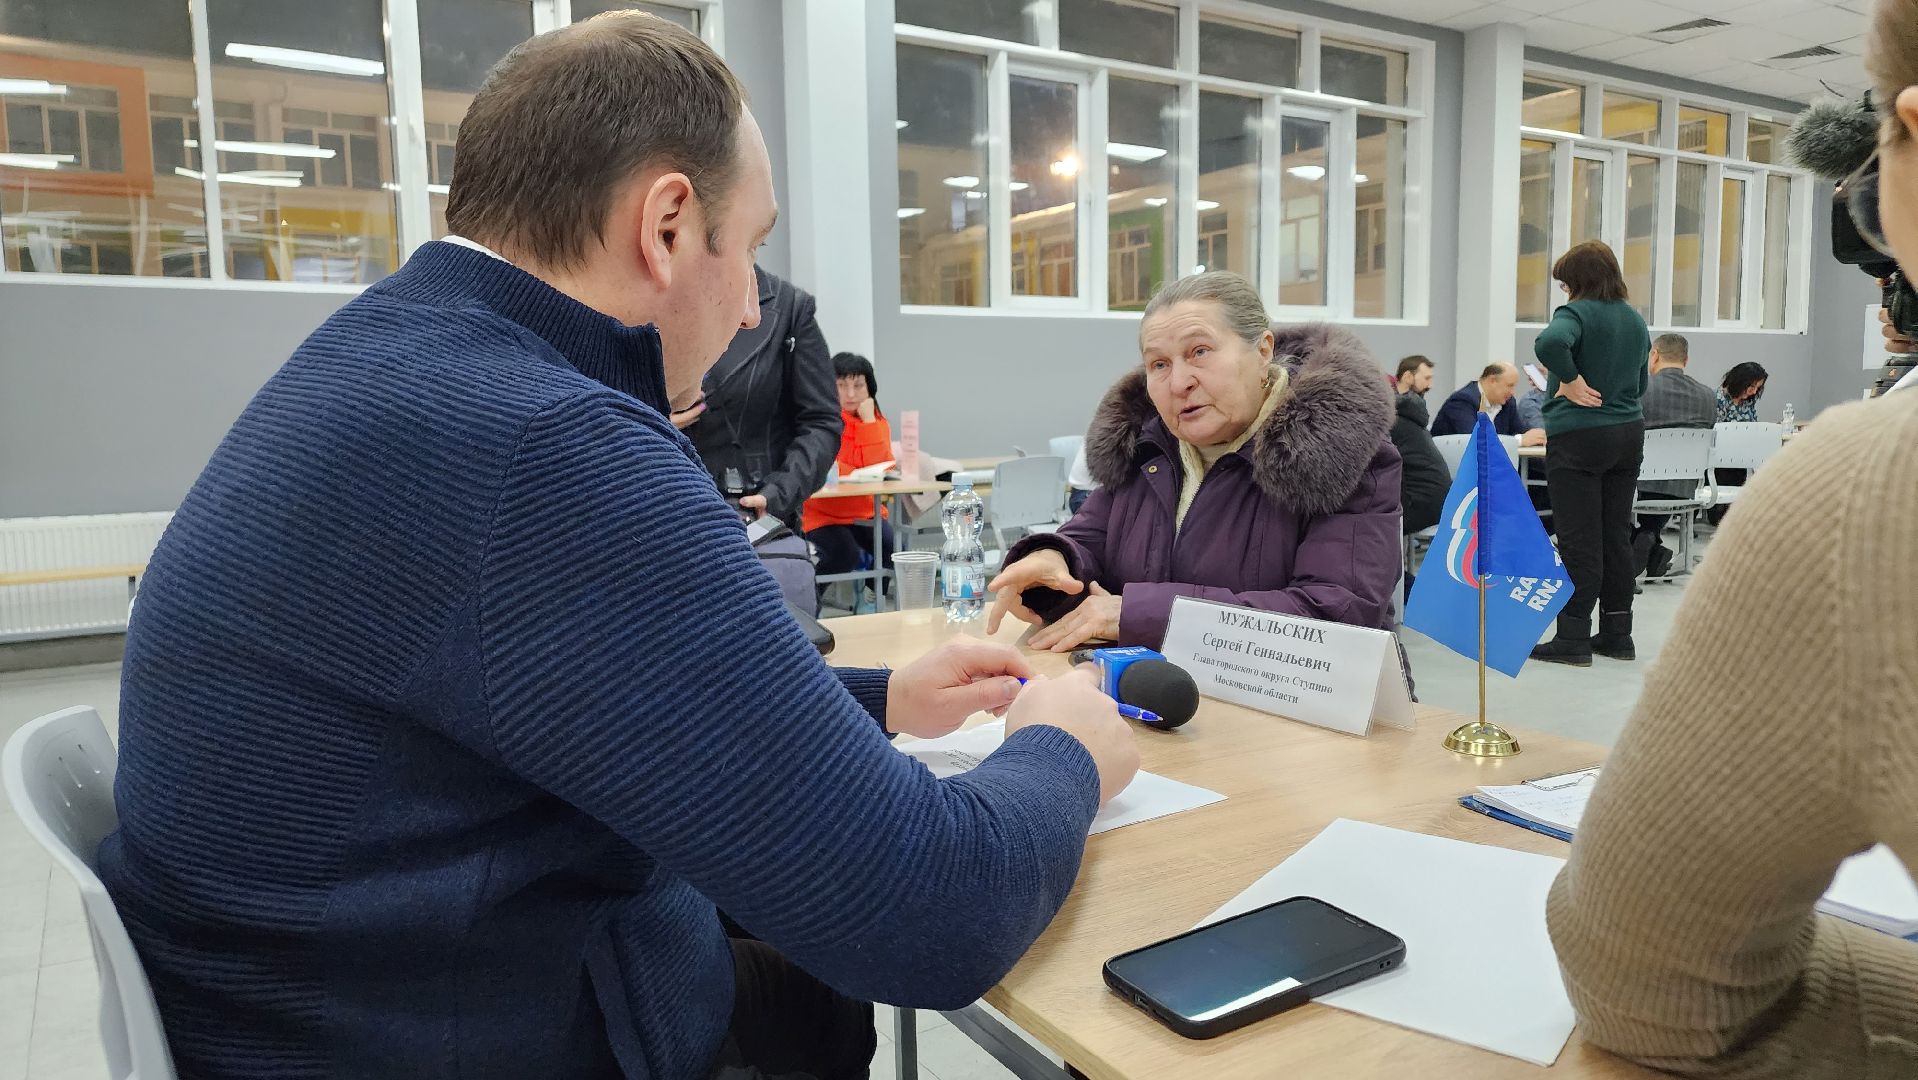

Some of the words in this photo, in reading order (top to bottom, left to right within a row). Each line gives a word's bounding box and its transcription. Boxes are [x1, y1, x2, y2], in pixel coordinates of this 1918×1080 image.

[1218, 610, 1328, 644] МУЖАЛЬСКИХ
[1202, 632, 1243, 653] Сергей
[1245, 640, 1332, 672] Геннадьевич
[1192, 652, 1215, 666] Глава
[1216, 660, 1259, 676] городского
[1260, 670, 1290, 684] округа
[1292, 676, 1333, 694] Ступино
[1214, 673, 1264, 694] Московской
[1263, 688, 1299, 704] области
